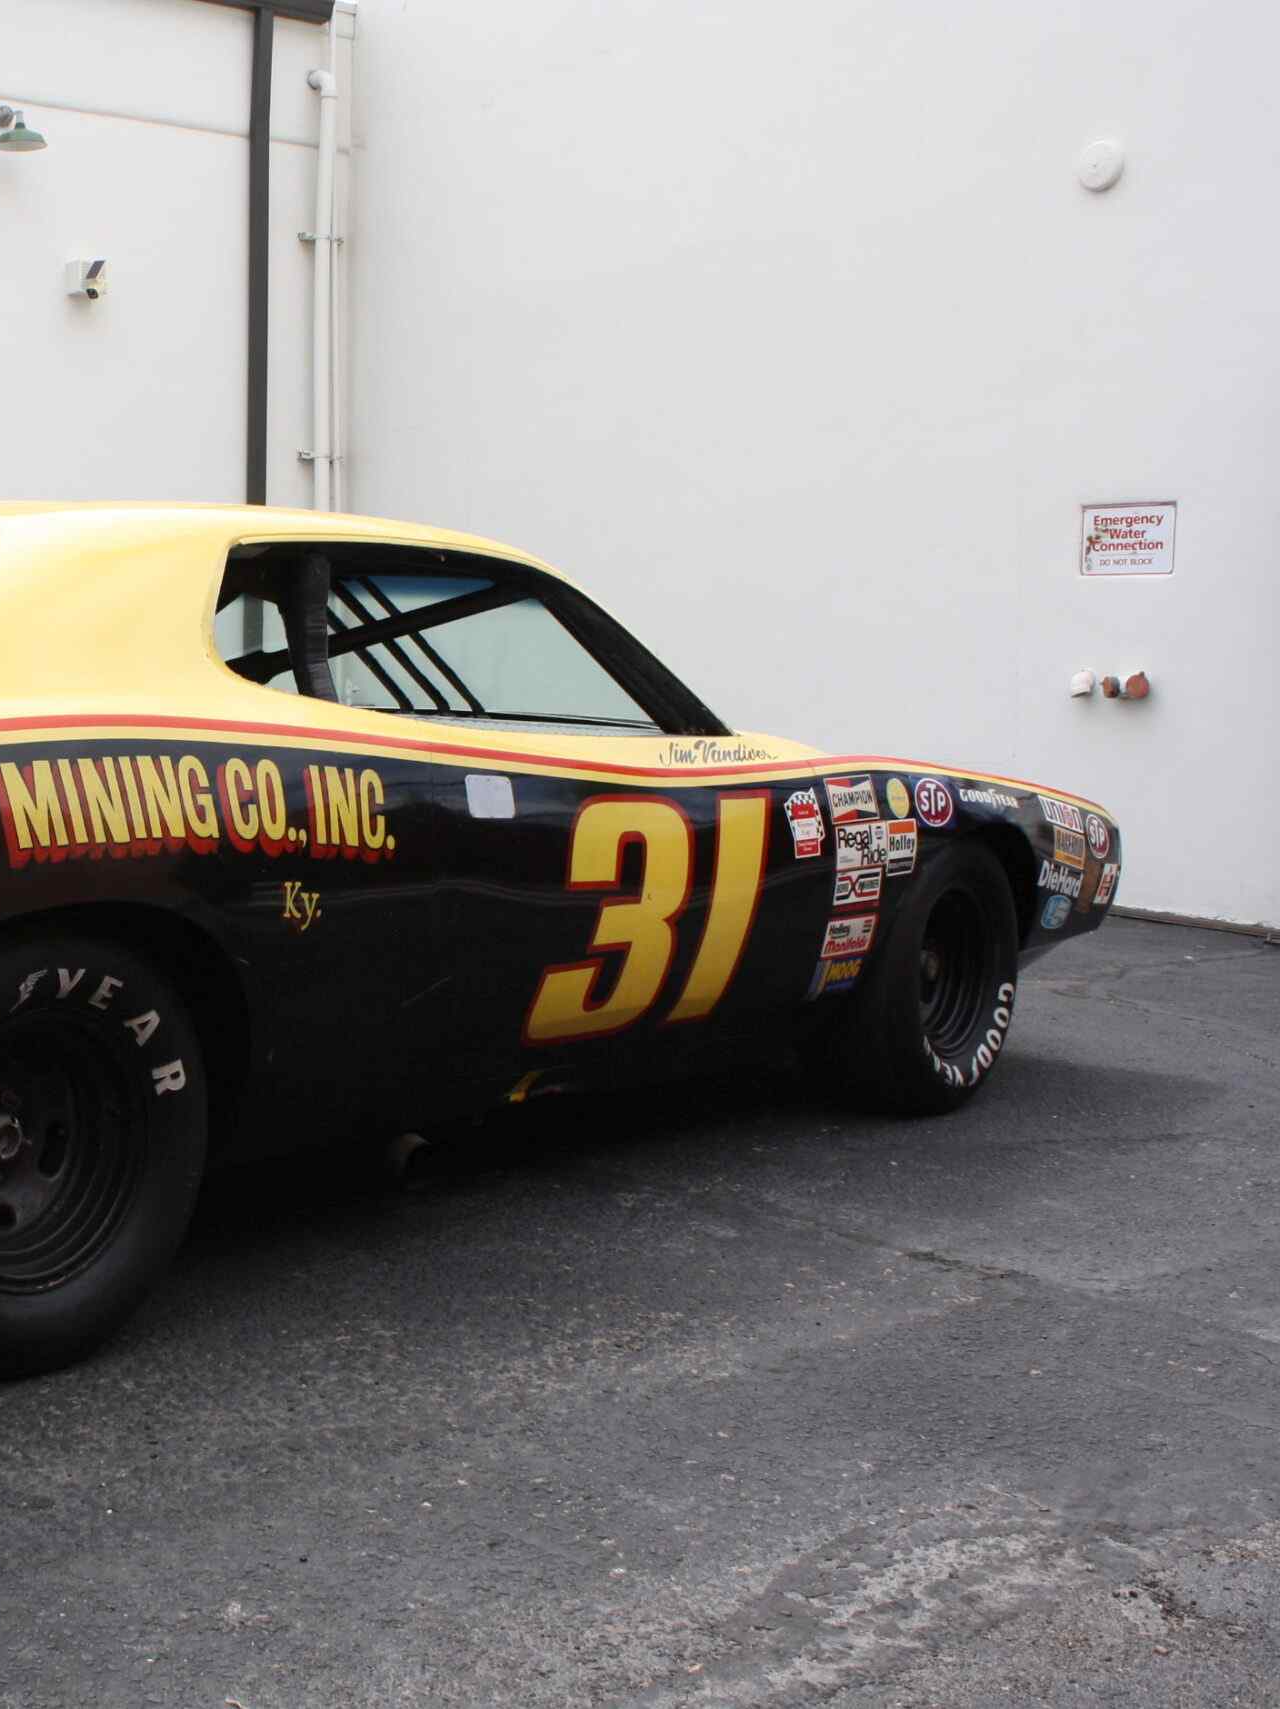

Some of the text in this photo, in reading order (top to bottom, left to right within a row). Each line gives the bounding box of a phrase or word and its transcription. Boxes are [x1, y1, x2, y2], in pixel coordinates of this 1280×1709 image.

[1093, 514, 1164, 527] Emergency
[1109, 528, 1147, 540] Water
[1092, 540, 1164, 553] Connection
[659, 741, 698, 768] Jim
[0, 754, 220, 850] MINING
[223, 756, 308, 846] CO.,
[307, 763, 396, 851] INC.
[831, 789, 874, 808] CHAMPION
[919, 782, 947, 816] STP
[837, 825, 873, 850] Regal
[1089, 818, 1106, 849] STP
[860, 844, 888, 866] Ride
[1037, 859, 1084, 899] DieHard
[282, 881, 322, 931] Ky.
[524, 791, 770, 1044] 31
